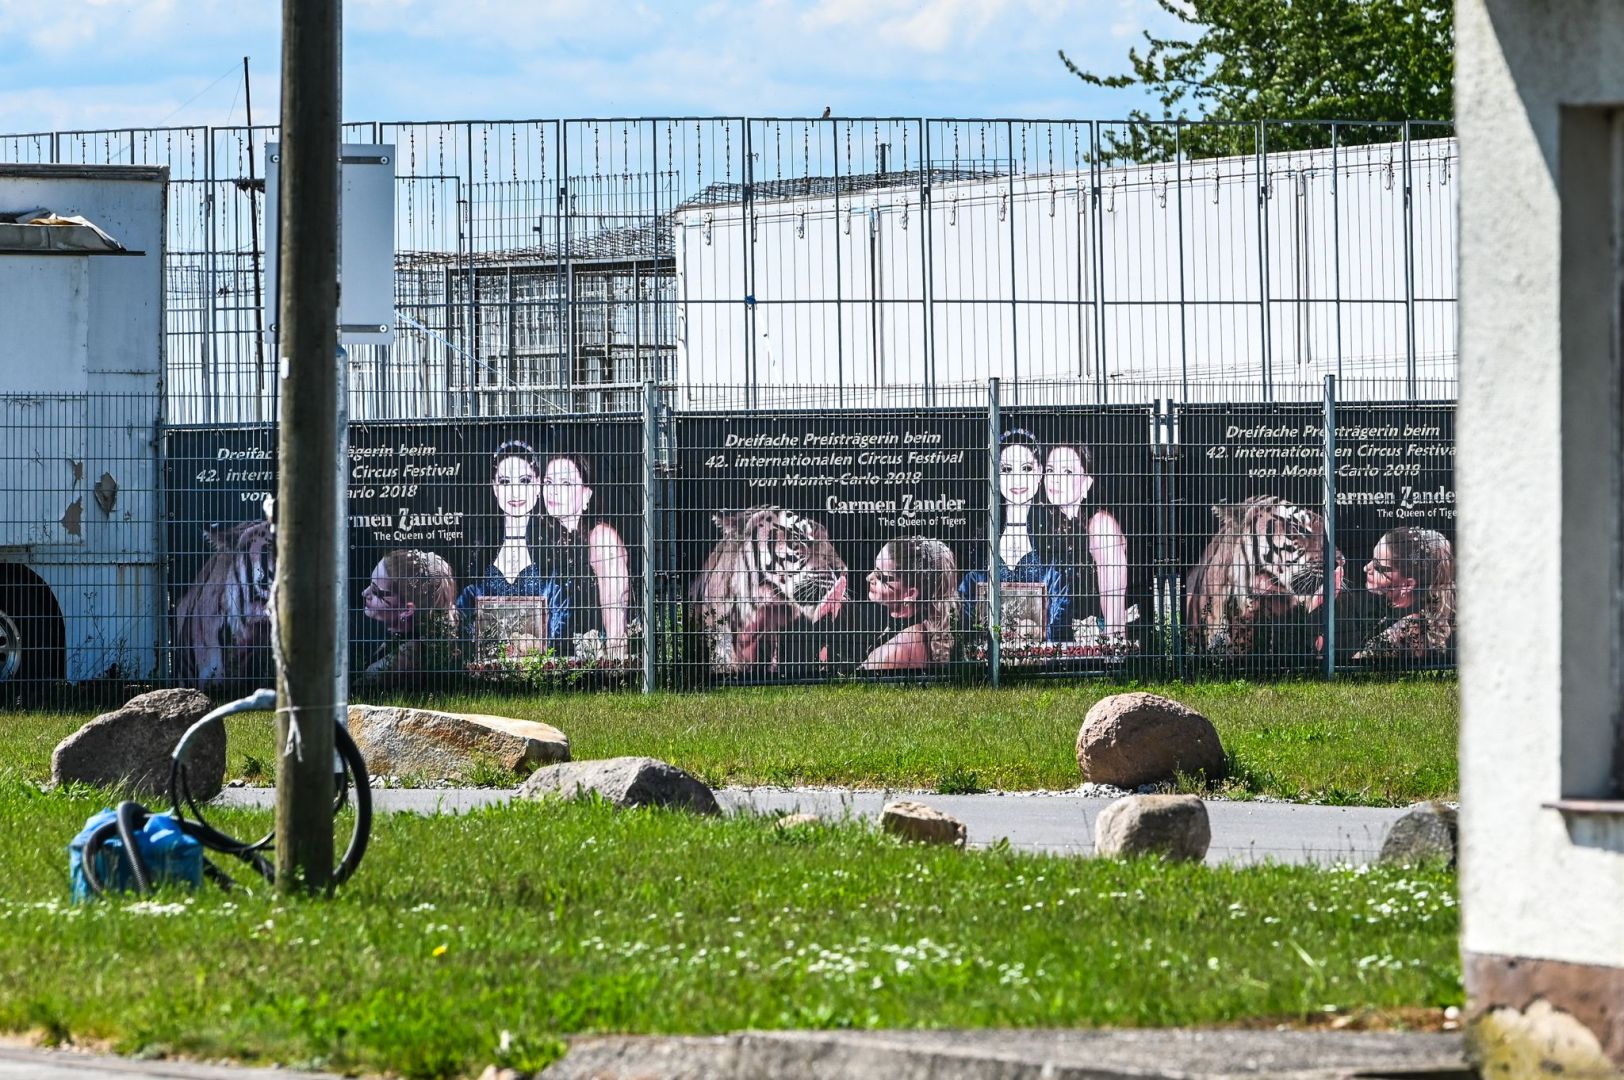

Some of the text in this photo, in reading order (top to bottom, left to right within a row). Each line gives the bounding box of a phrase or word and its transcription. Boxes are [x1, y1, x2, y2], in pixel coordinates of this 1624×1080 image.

[725, 430, 941, 448] Dreifache Preisträgerin beim
[1226, 423, 1440, 441] Dreifache Presträgerin beim
[399, 443, 436, 457] beim
[1206, 445, 1229, 459] 42.
[1357, 443, 1403, 457] Circus
[1407, 442, 1457, 457] Festiva
[704, 450, 964, 468] 42. internationalen Circus Festival
[196, 468, 220, 482] 42.
[352, 464, 399, 478] Circus
[403, 462, 460, 477] Festival
[748, 471, 922, 487] von Monte-Carlo 2018
[1248, 463, 1421, 478] von Mont-Carlo 2018
[379, 485, 418, 498] 2018
[1334, 485, 1458, 509] armen Zande
[826, 494, 966, 517] Carmen Zander
[1377, 507, 1458, 519] The Queen of Tige
[398, 506, 463, 532] Zander
[878, 516, 967, 528] The Queen of Tigers
[373, 529, 464, 541] The Queen of Tigers
